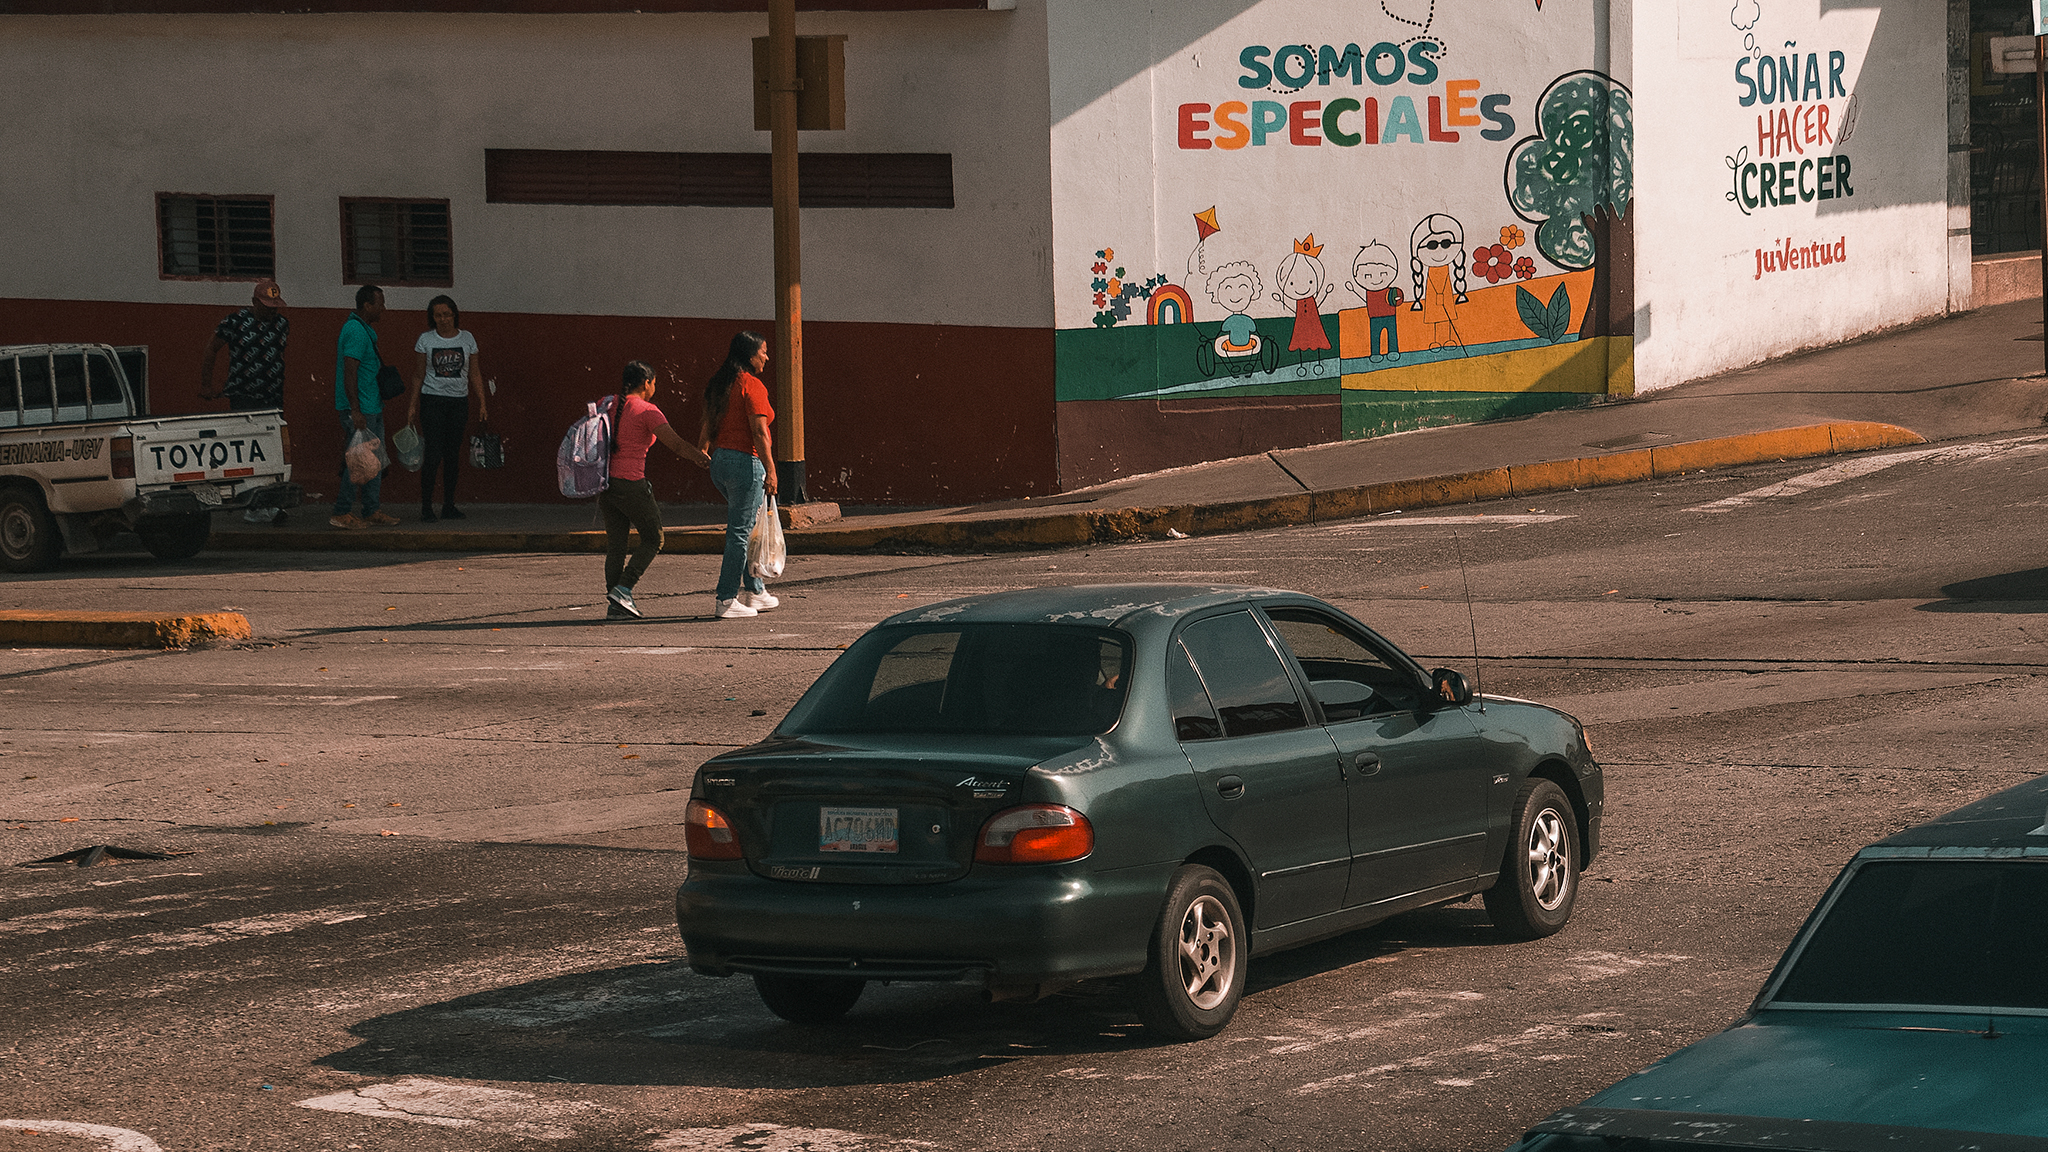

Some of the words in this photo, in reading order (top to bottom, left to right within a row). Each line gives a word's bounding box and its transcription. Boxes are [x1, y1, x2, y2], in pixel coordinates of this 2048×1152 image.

[1238, 42, 1439, 89] SOMOS
[1735, 40, 1846, 107] SOÑAR
[1177, 79, 1516, 150] ESPECIALES
[1757, 104, 1833, 158] HACER
[1741, 154, 1854, 209] CRECER
[270, 288, 278, 297] P
[240, 317, 254, 331] FILA
[240, 331, 257, 346] FILA
[260, 331, 276, 346] FILA
[243, 346, 260, 361] FILA
[263, 346, 277, 361] FILA
[244, 362, 262, 377] FILA
[267, 362, 282, 377] FILA
[150, 439, 267, 471] TOYOTA
[955, 776, 1010, 788] Accent
